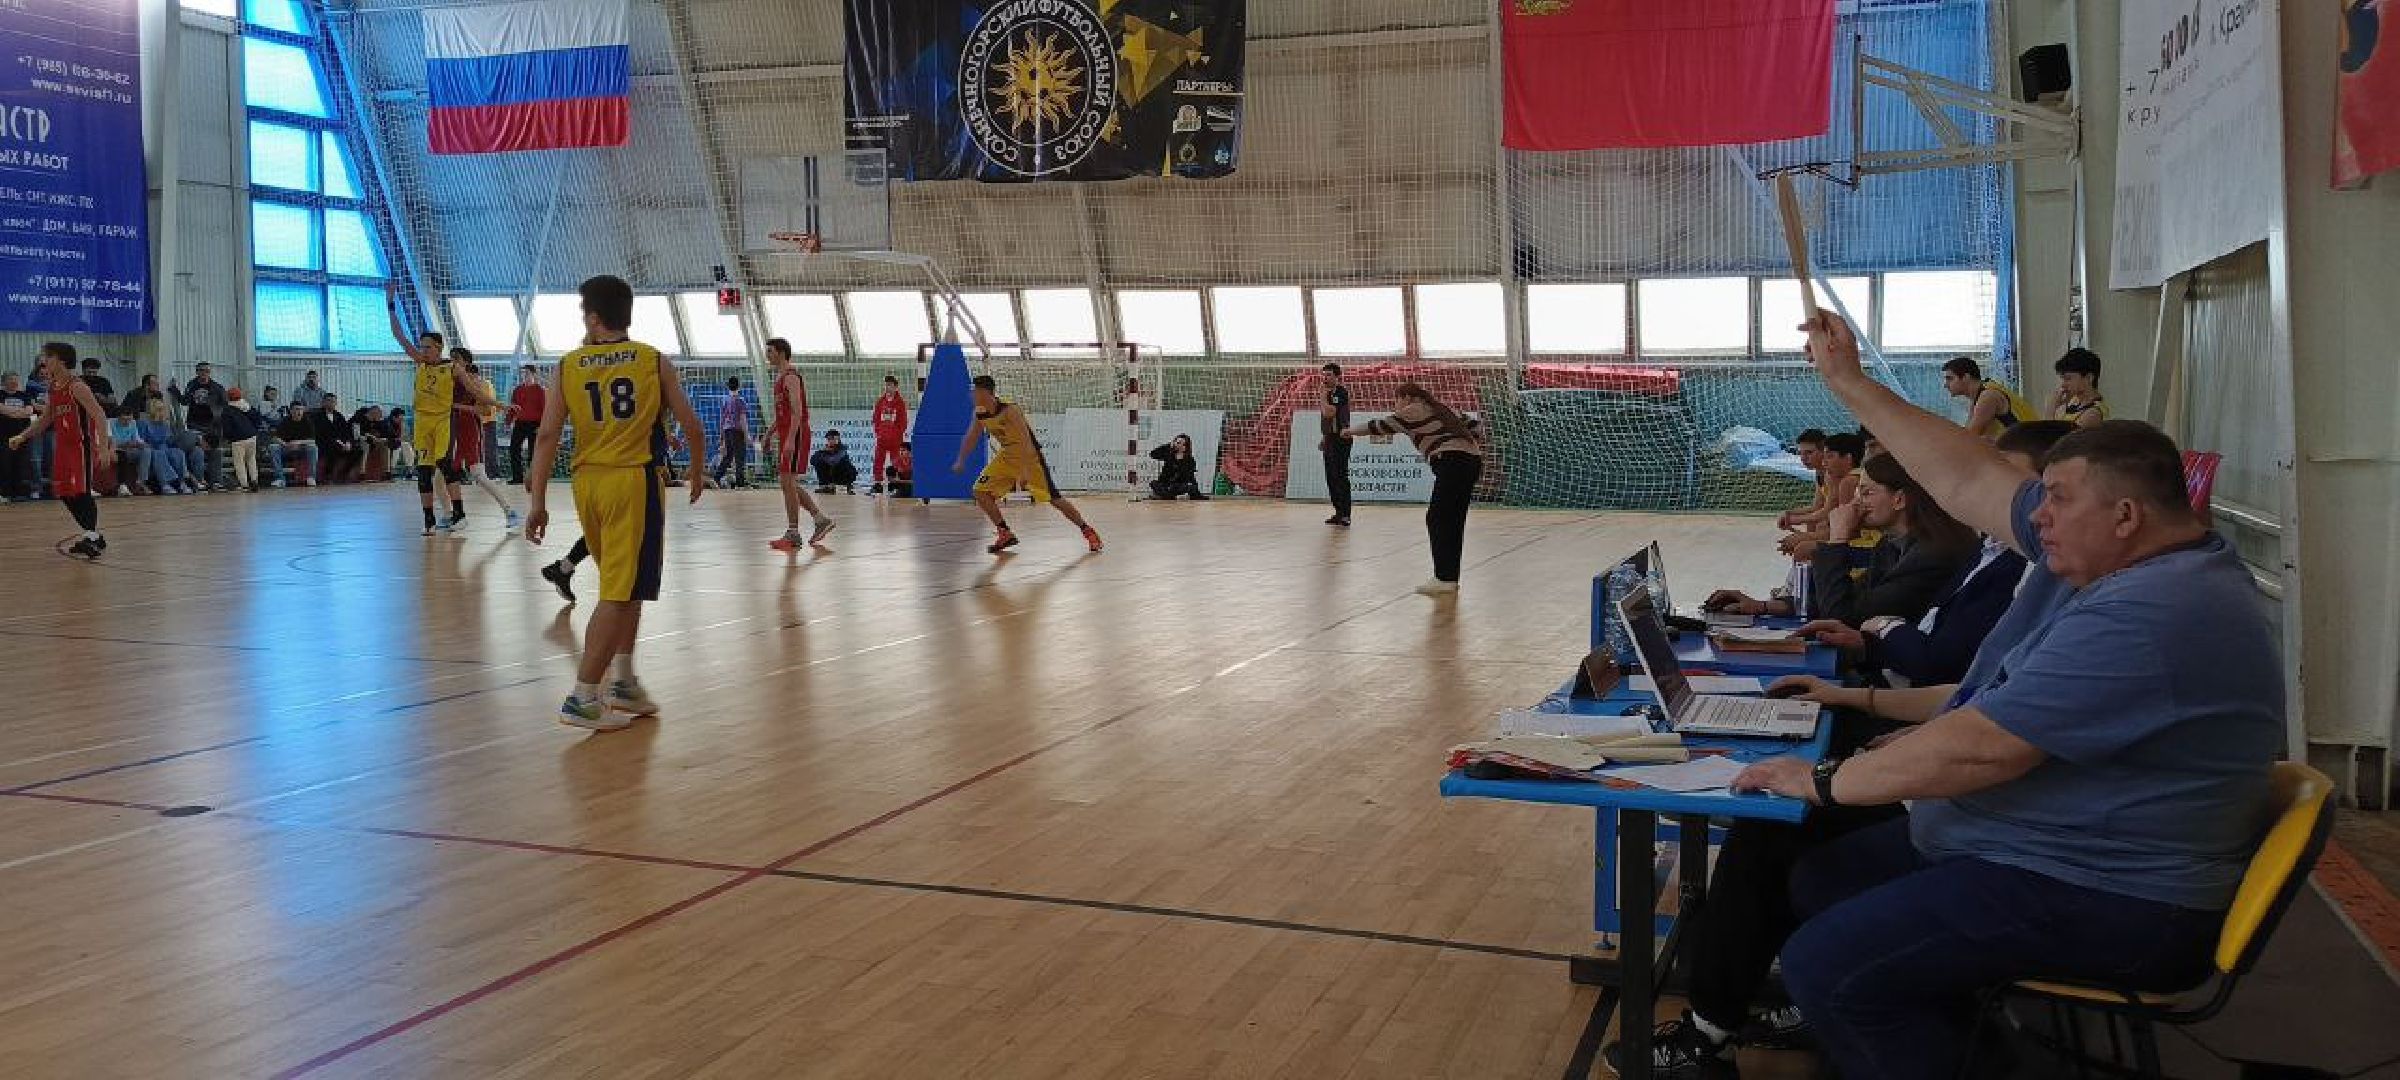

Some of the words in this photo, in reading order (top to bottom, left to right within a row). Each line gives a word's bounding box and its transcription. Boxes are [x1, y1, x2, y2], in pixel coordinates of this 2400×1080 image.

[1054, 109, 1101, 161] СОЮЗ
[23, 150, 69, 171] РАБОТ
[98, 224, 138, 240] ГАРАЖ
[584, 376, 637, 422] 18
